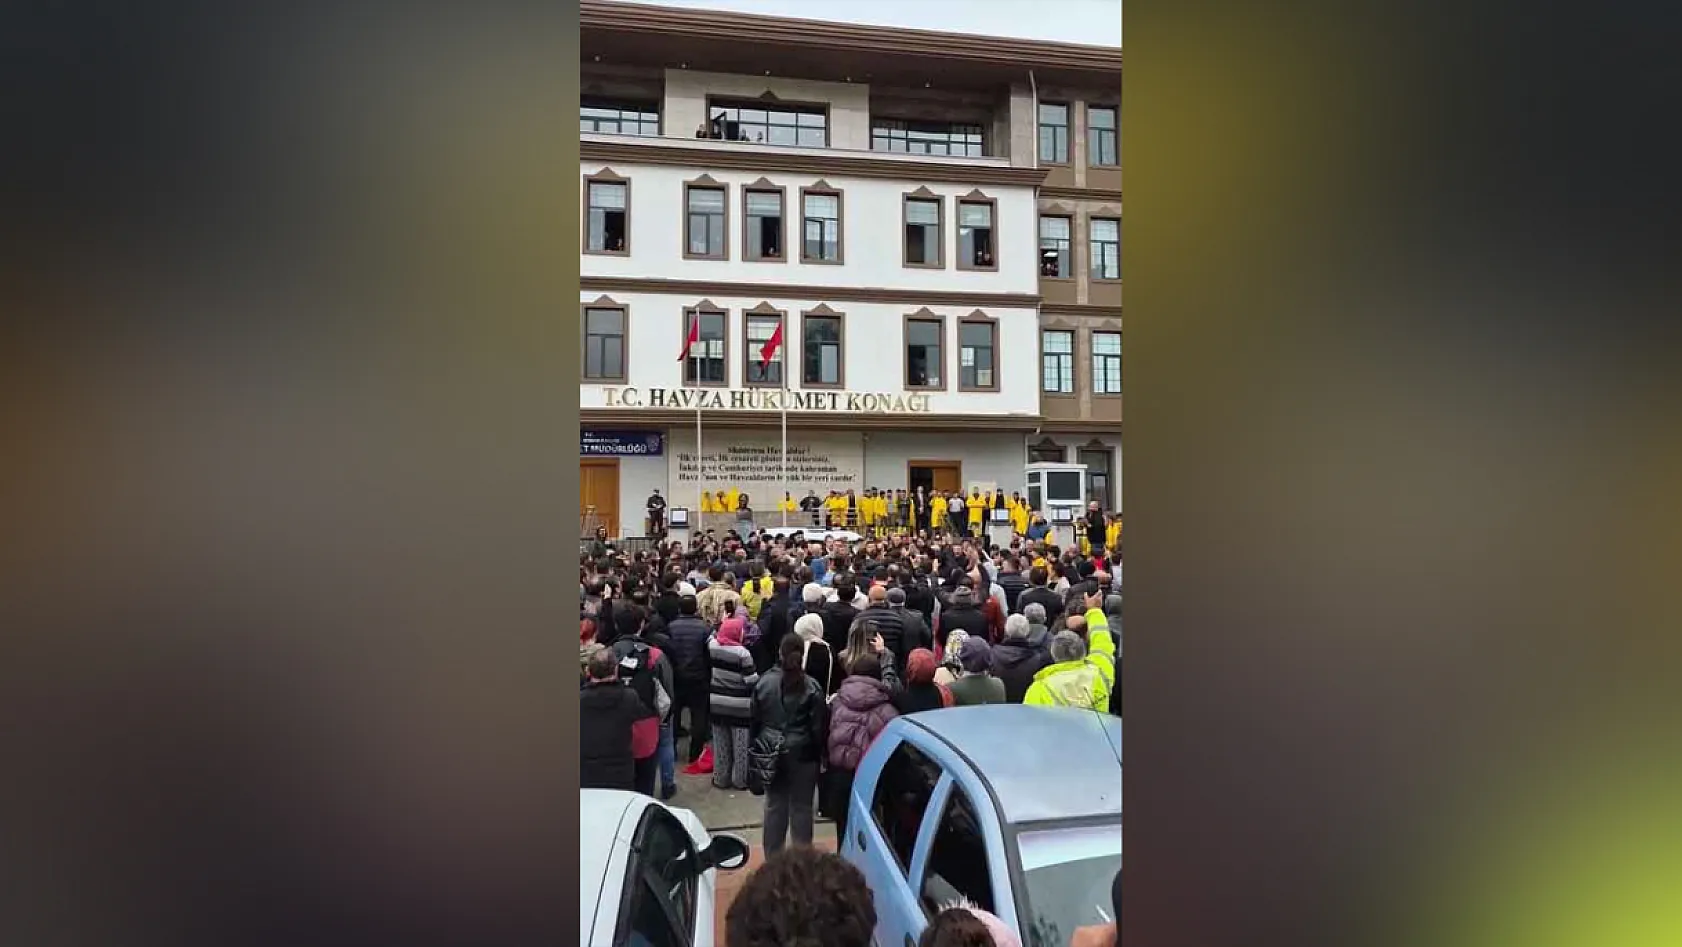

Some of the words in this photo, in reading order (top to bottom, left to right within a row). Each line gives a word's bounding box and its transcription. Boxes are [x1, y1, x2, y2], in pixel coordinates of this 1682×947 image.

[603, 387, 642, 407] T.C.
[649, 387, 724, 409] HAVZA
[730, 386, 840, 411] HÜKÜMET
[847, 390, 933, 412] KONAĞI
